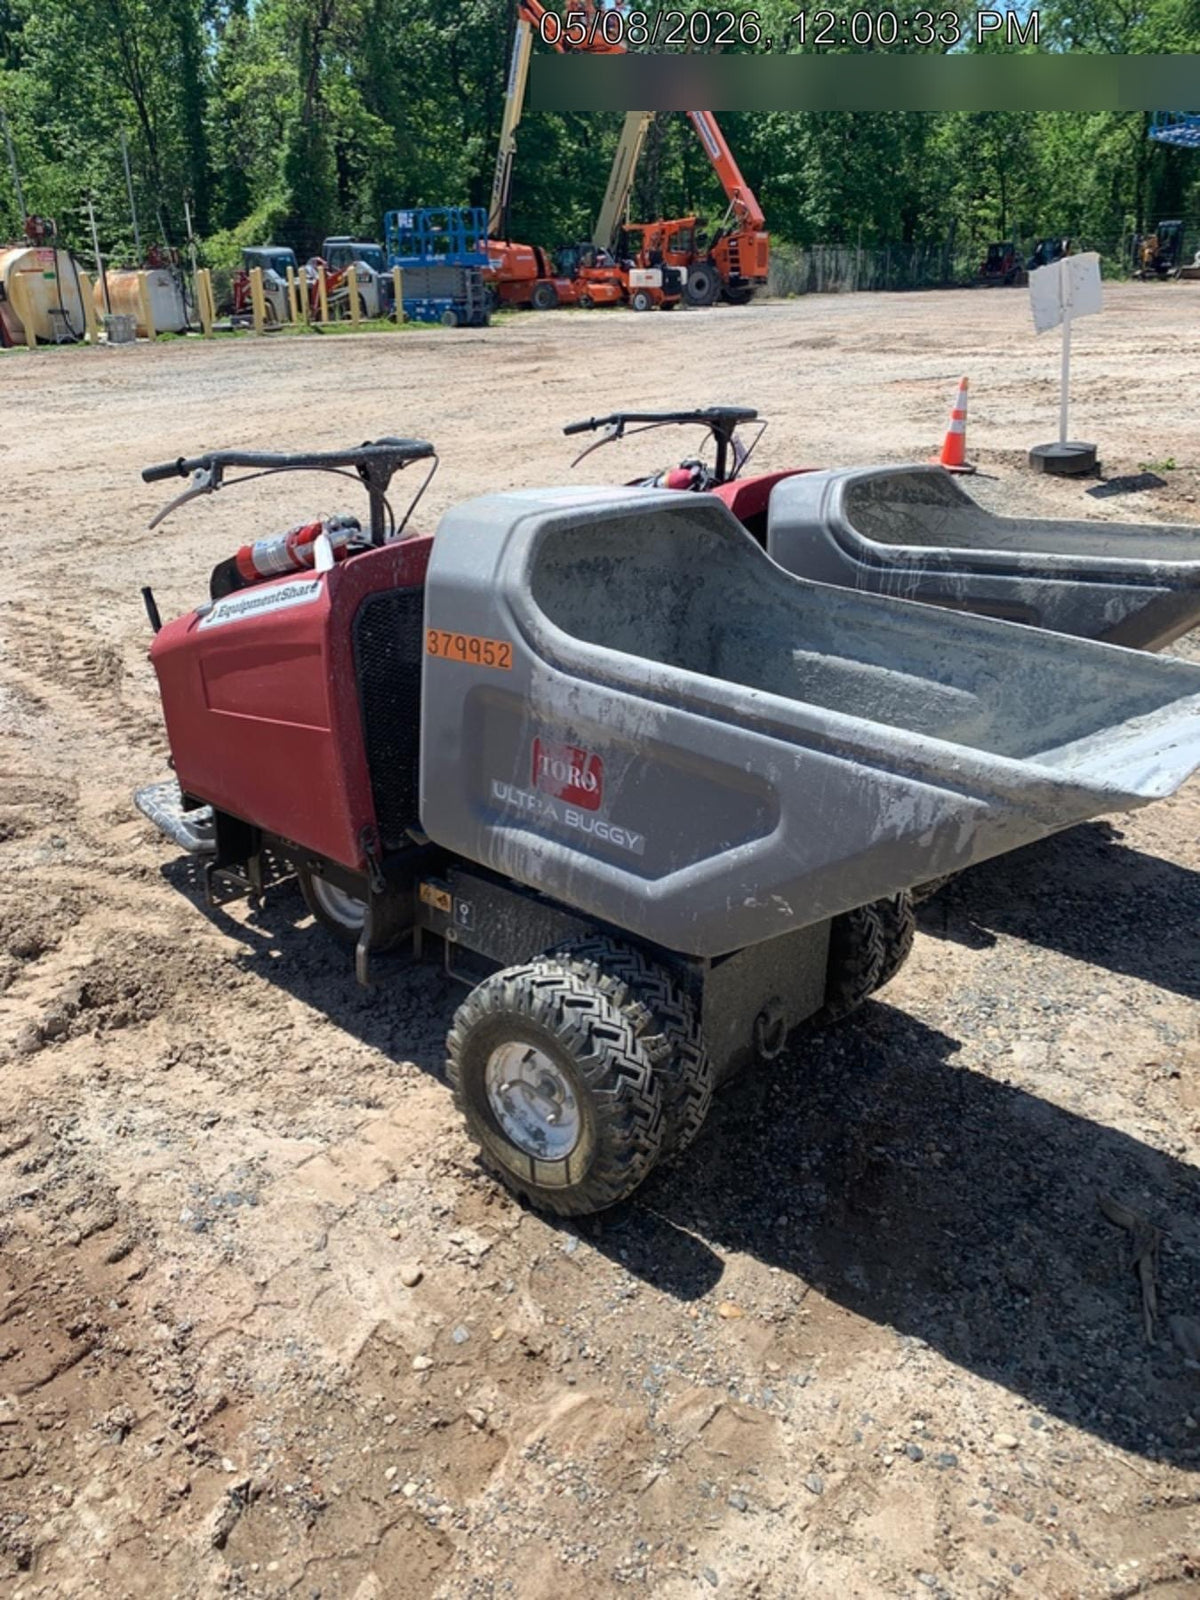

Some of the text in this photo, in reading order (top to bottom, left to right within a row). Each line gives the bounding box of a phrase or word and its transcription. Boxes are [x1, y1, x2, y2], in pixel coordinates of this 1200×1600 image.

[217, 582, 318, 618] EquipmentShare
[427, 630, 510, 668] 379952
[538, 754, 598, 792] TORO
[564, 809, 640, 849] BUGGY
